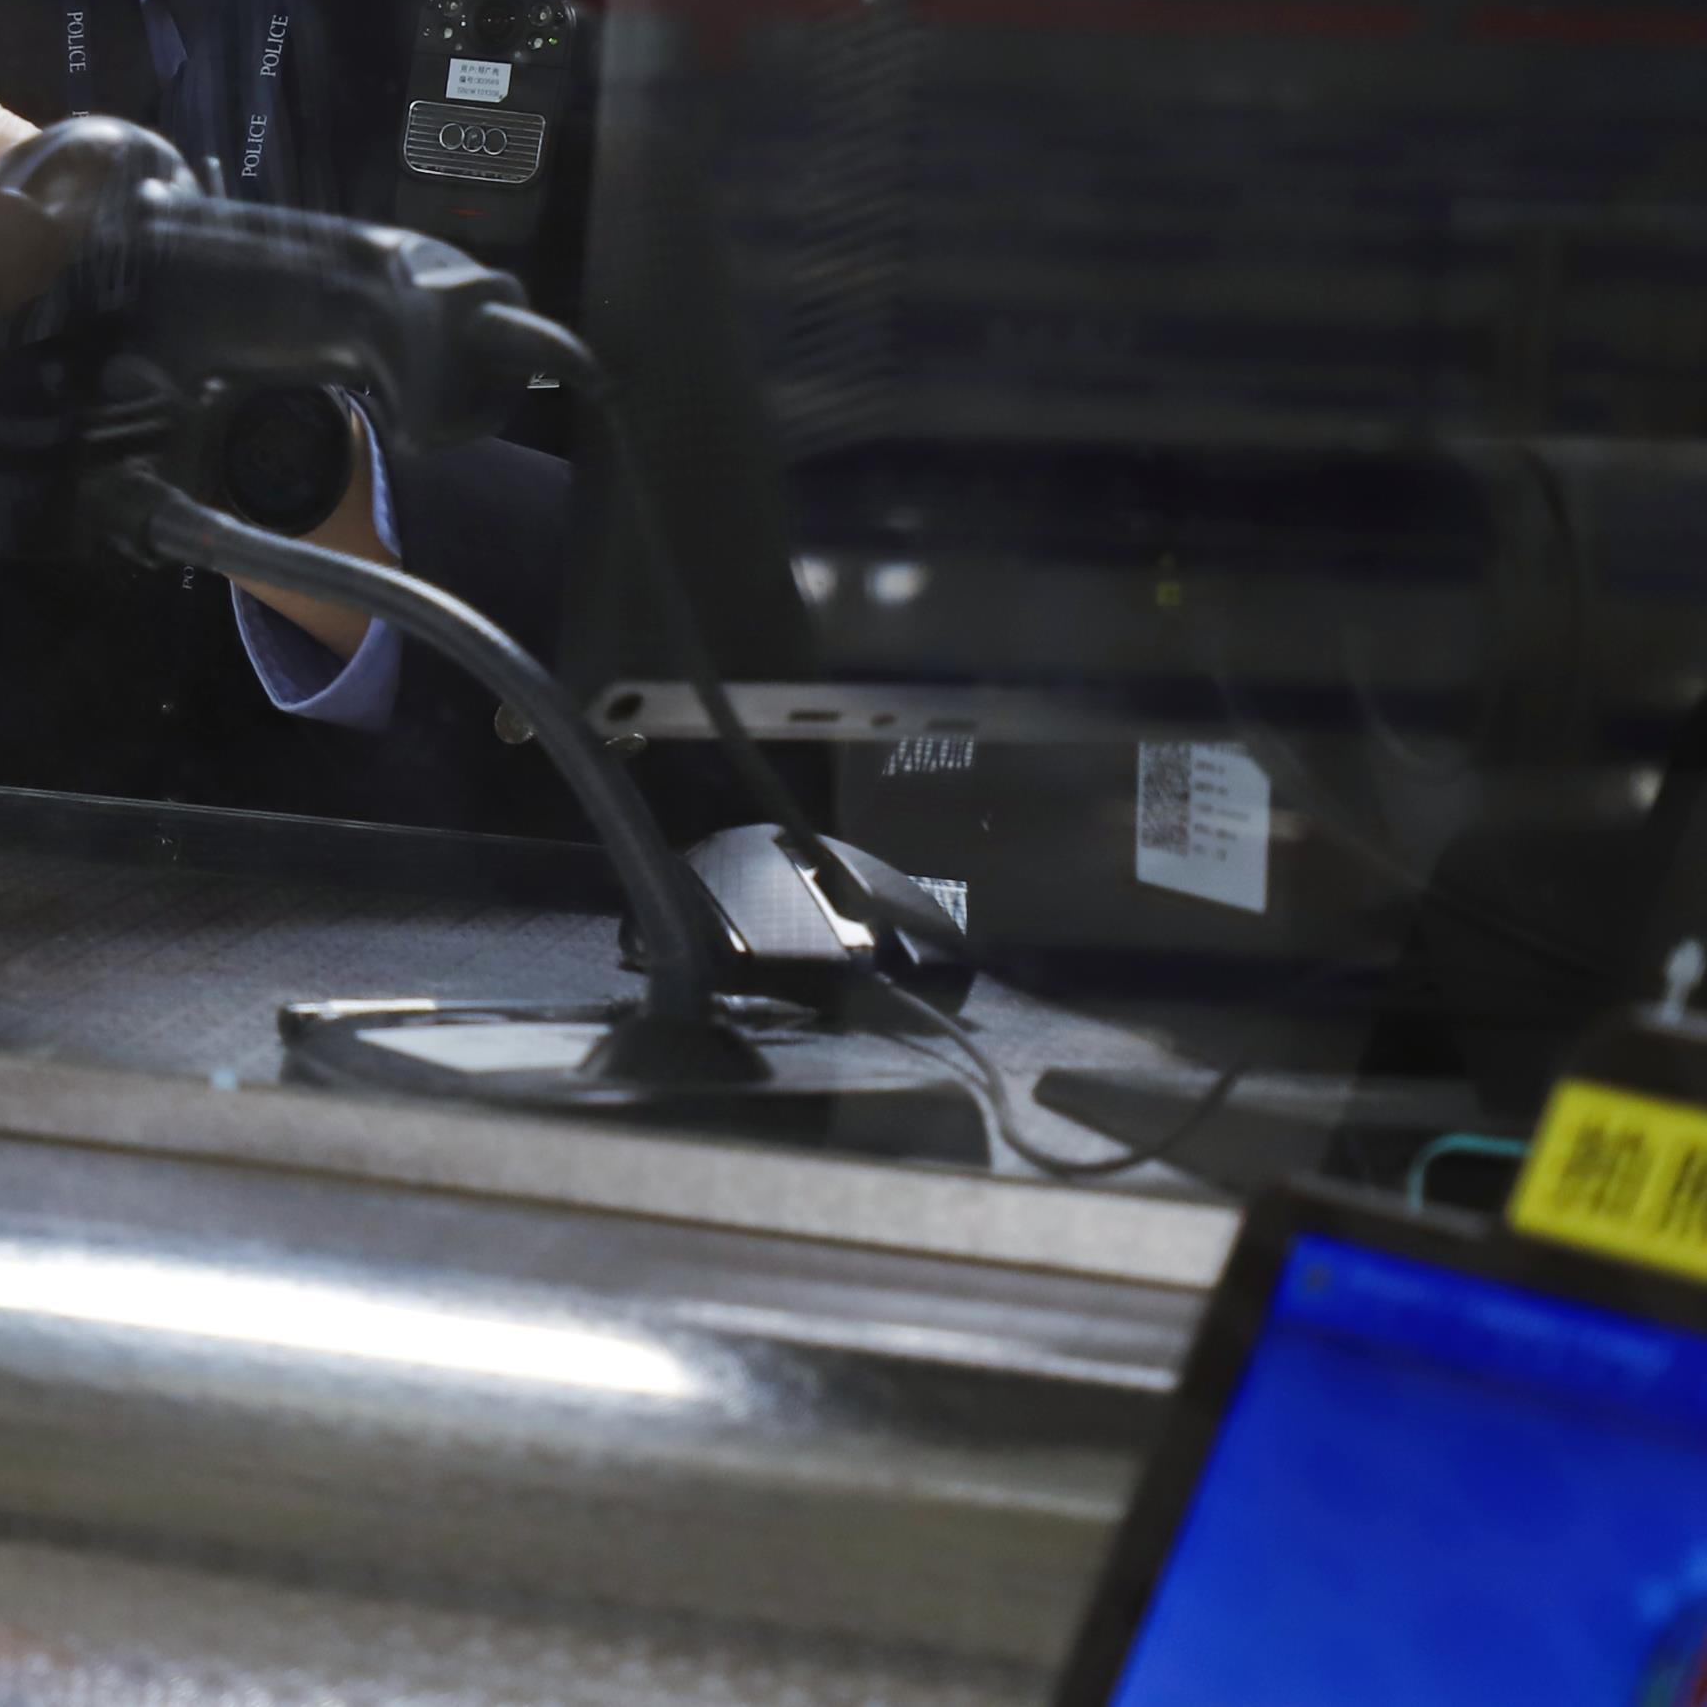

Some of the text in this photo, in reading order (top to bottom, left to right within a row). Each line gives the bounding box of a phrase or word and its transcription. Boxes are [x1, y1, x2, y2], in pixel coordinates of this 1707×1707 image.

[67, 11, 87, 73] POLICE
[260, 14, 289, 77] POLICE
[241, 114, 267, 177] POLICE
